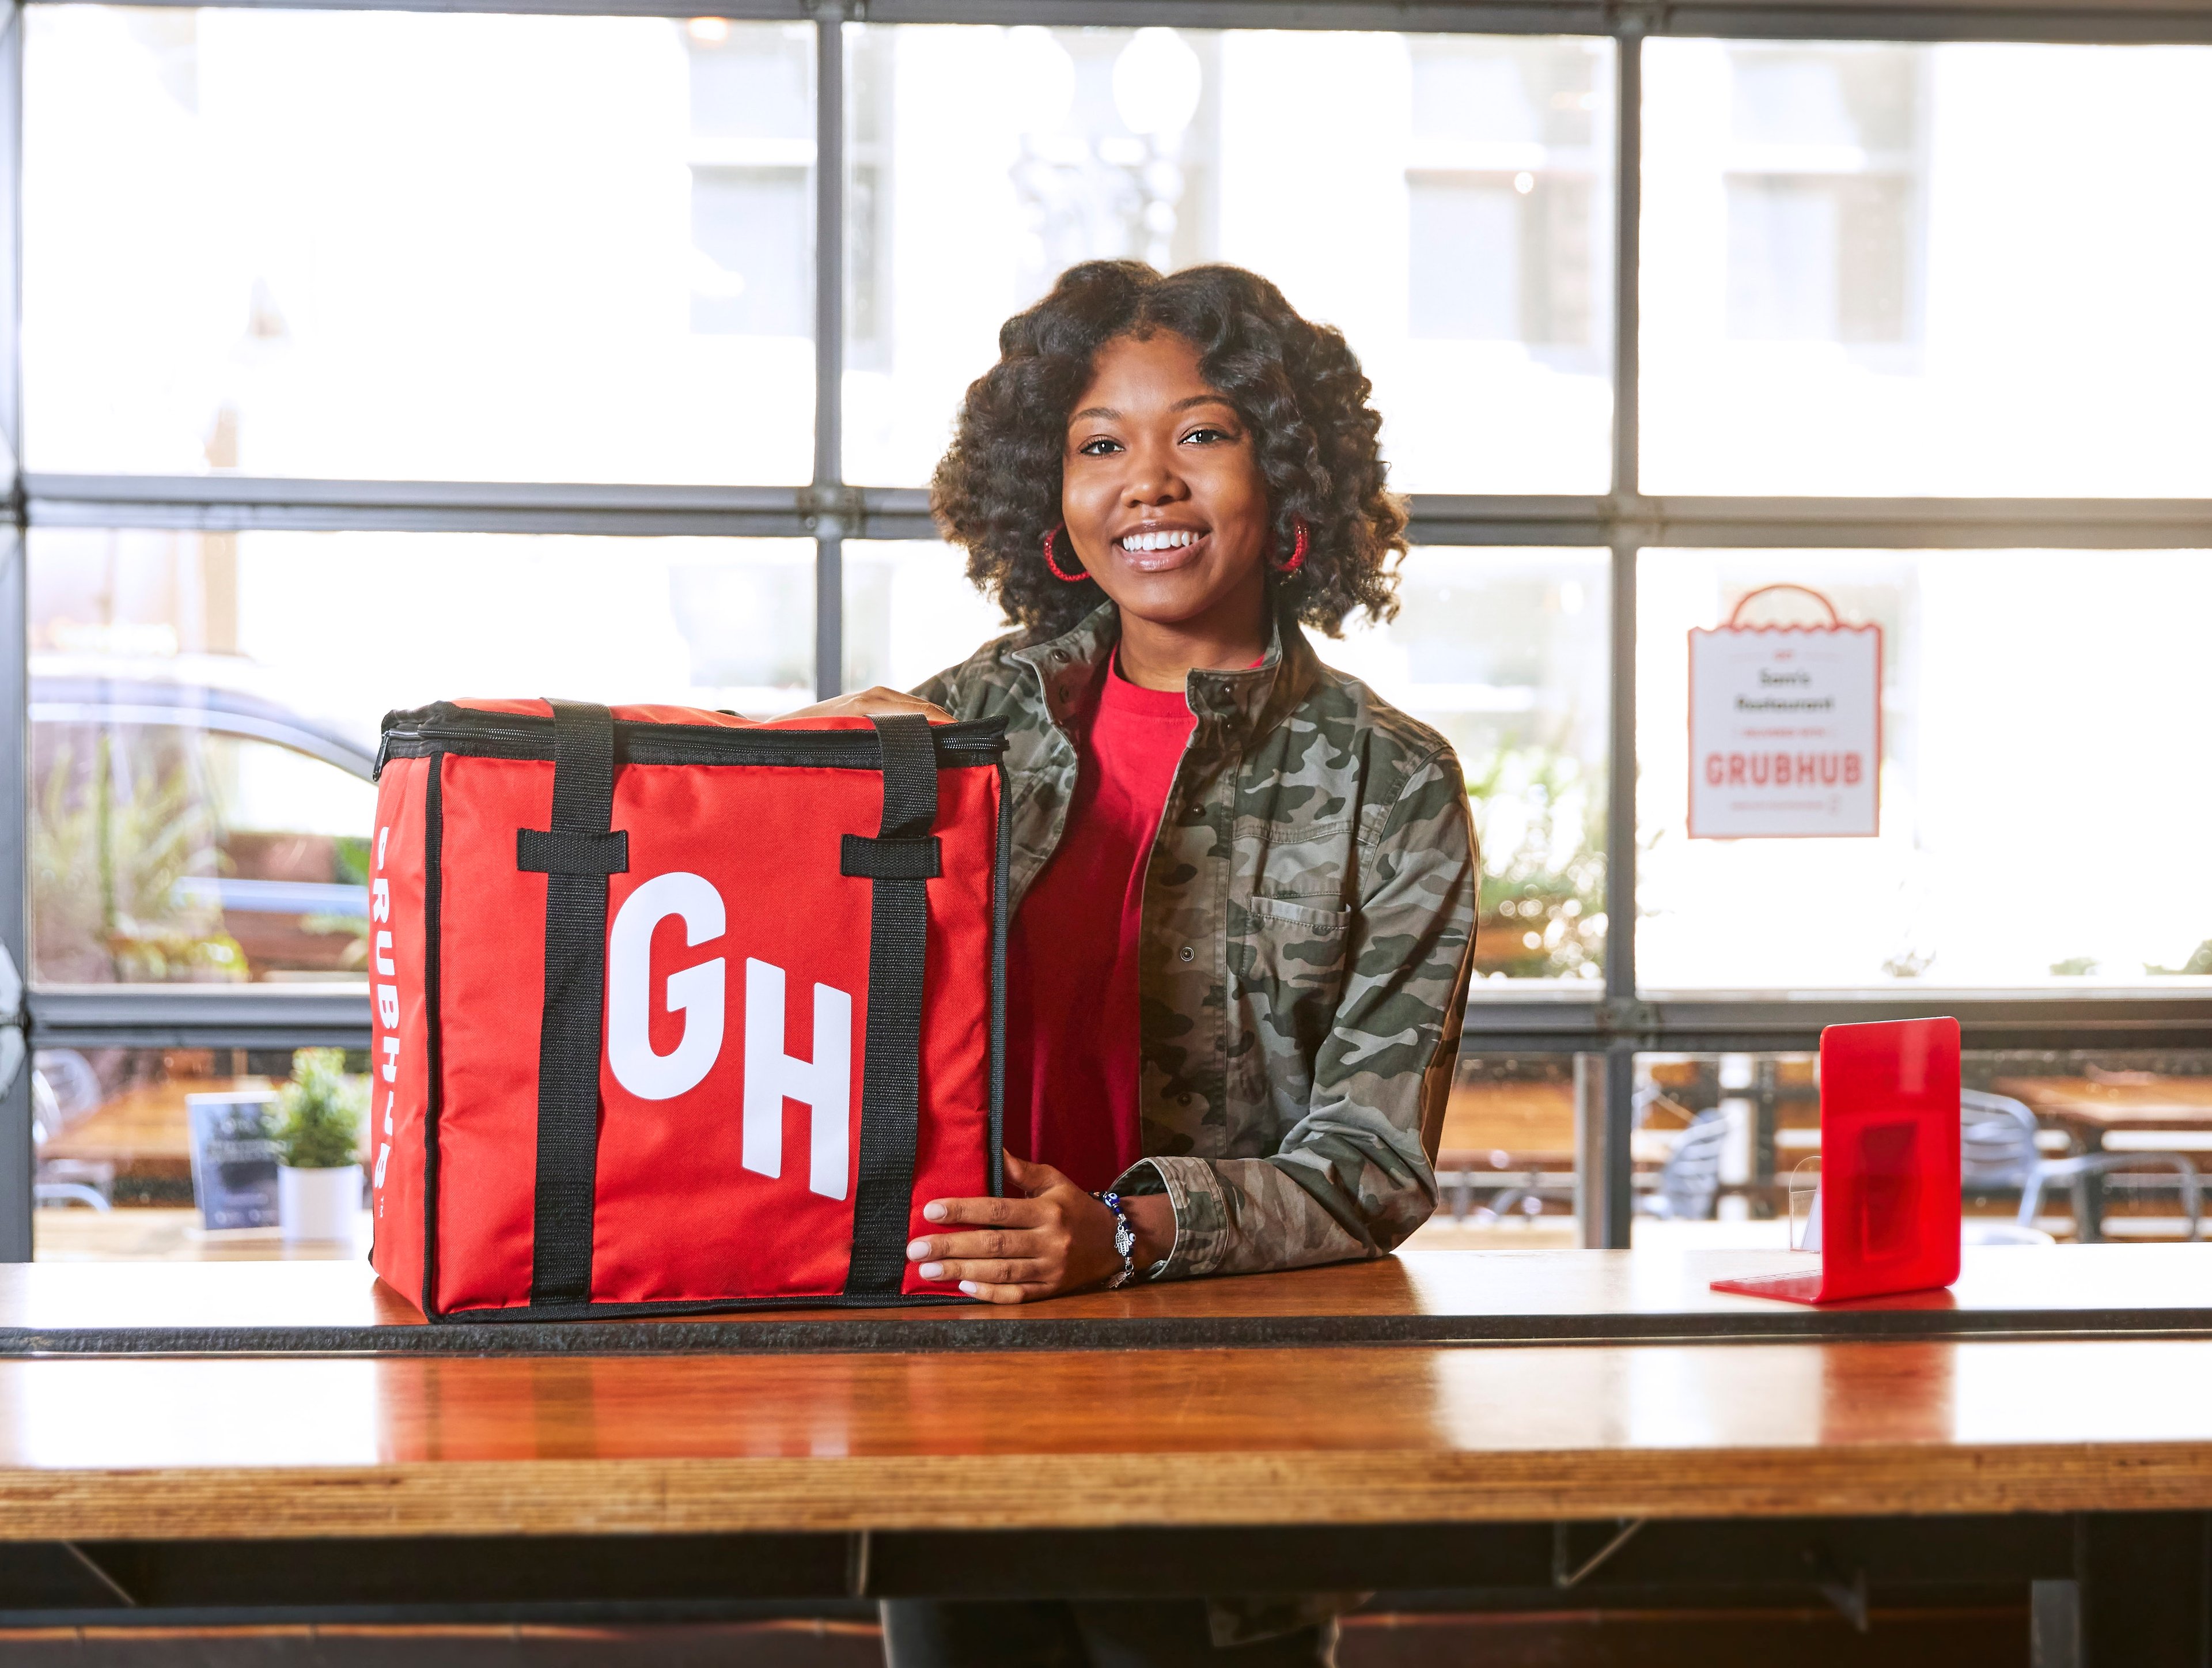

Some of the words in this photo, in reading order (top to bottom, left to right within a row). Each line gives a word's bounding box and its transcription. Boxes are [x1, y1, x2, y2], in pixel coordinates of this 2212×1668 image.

[1706, 752, 1863, 786] GRUBHUB
[608, 872, 851, 1201] GH
[1733, 1269, 1823, 1284] RUBHUB
